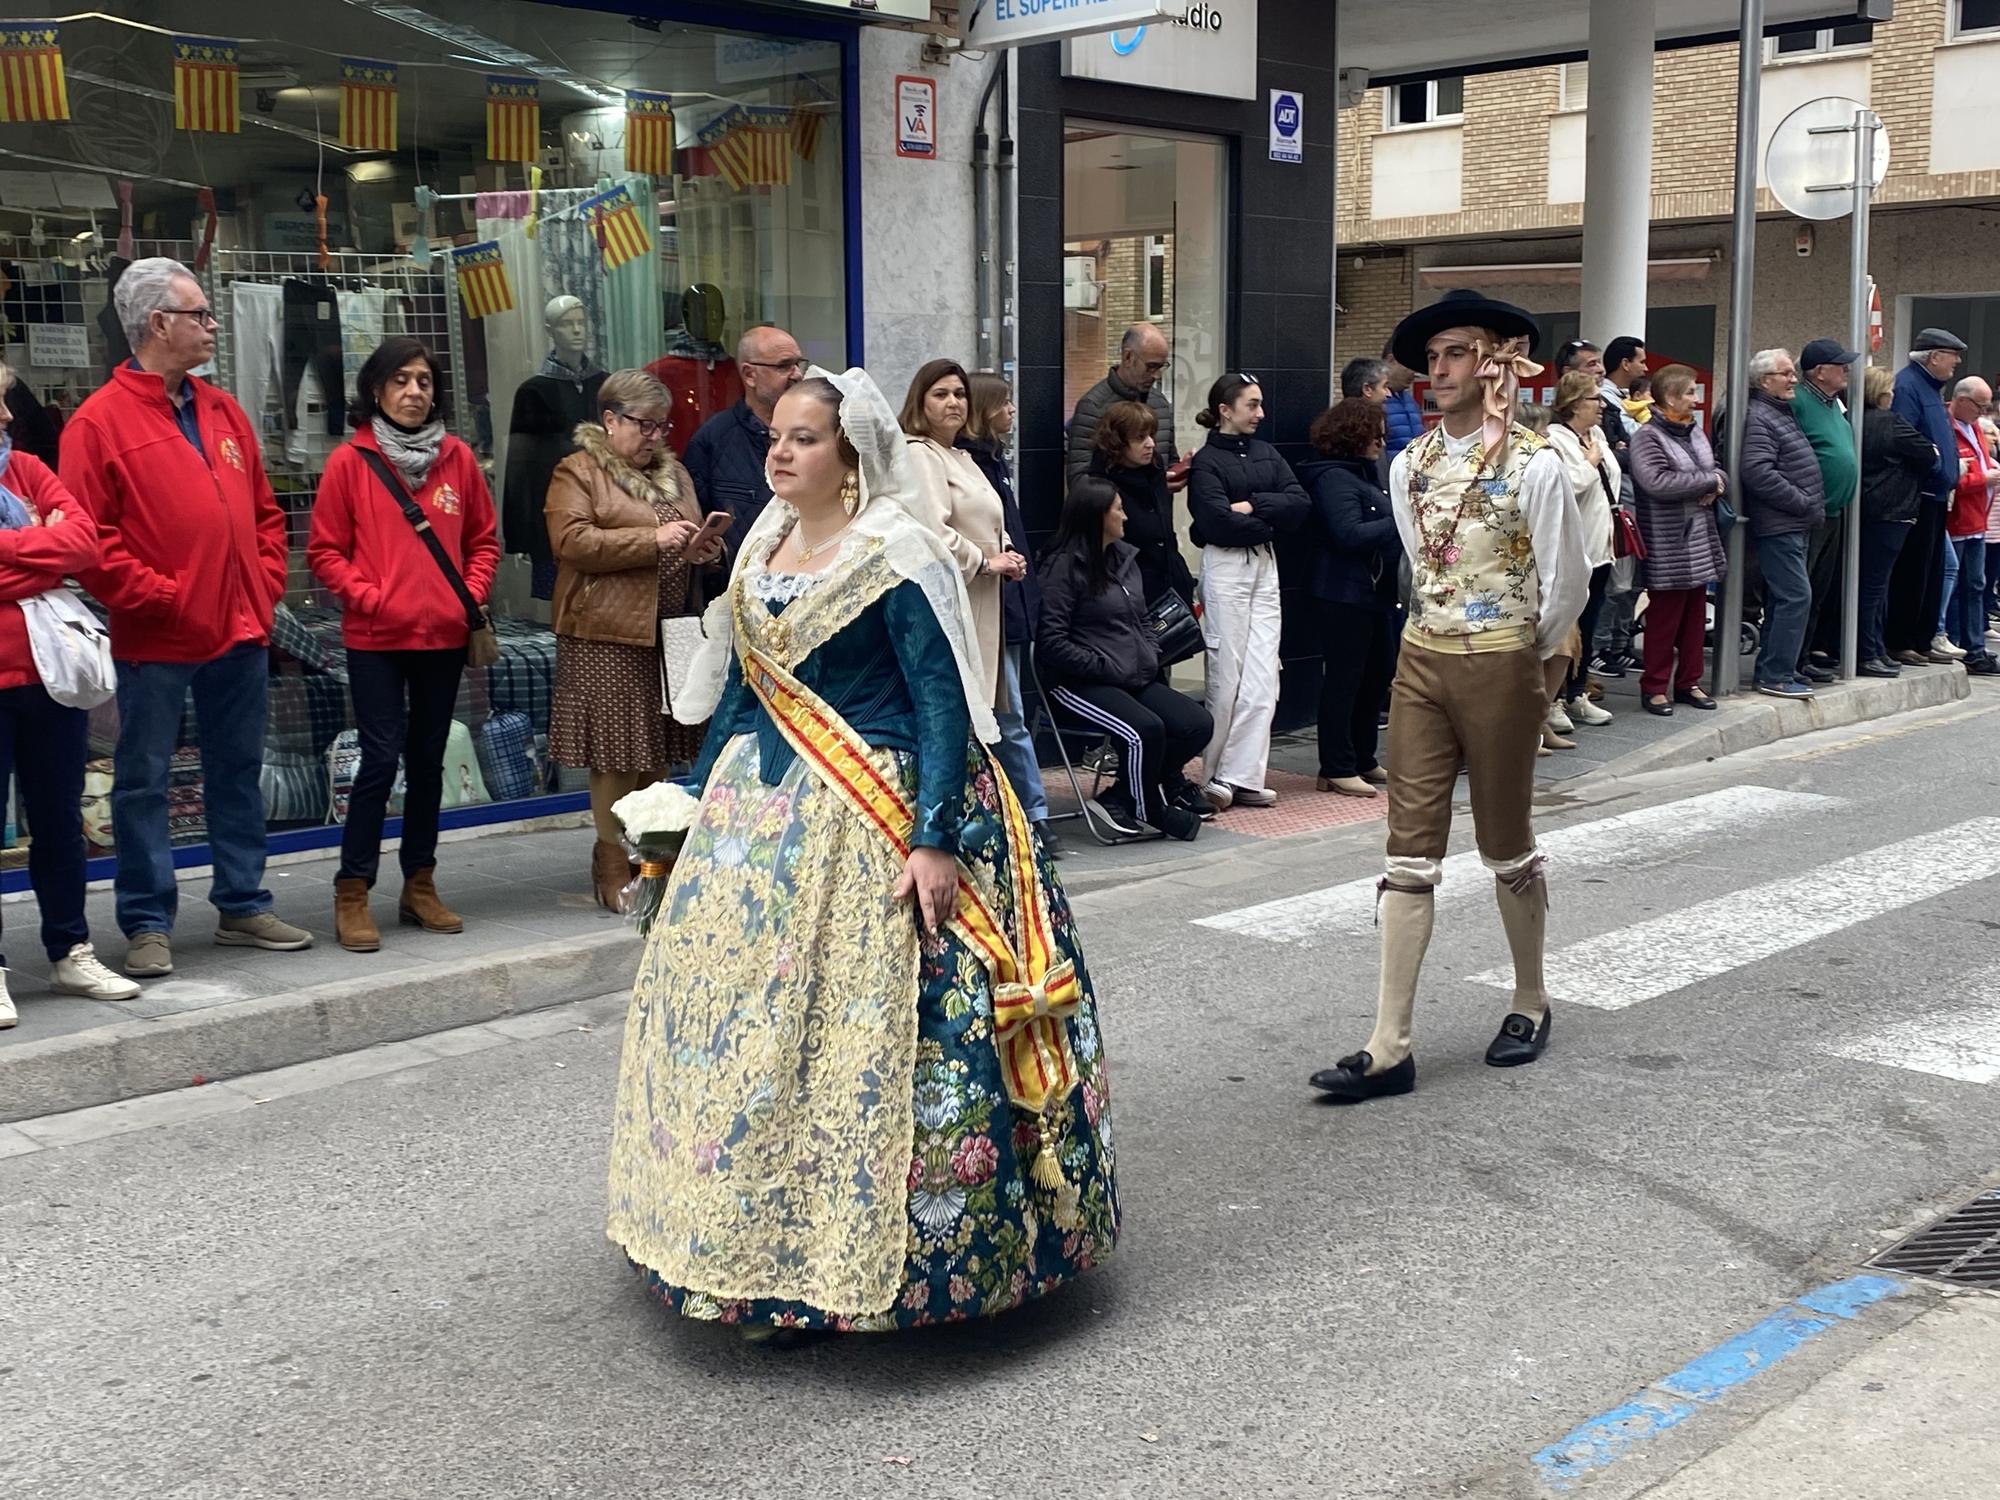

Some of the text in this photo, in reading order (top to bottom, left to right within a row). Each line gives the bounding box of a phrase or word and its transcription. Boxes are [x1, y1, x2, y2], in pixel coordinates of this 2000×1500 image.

[996, 0, 1015, 20] EL
[1170, 2, 1222, 30] udio
[1278, 108, 1296, 124] ADT
